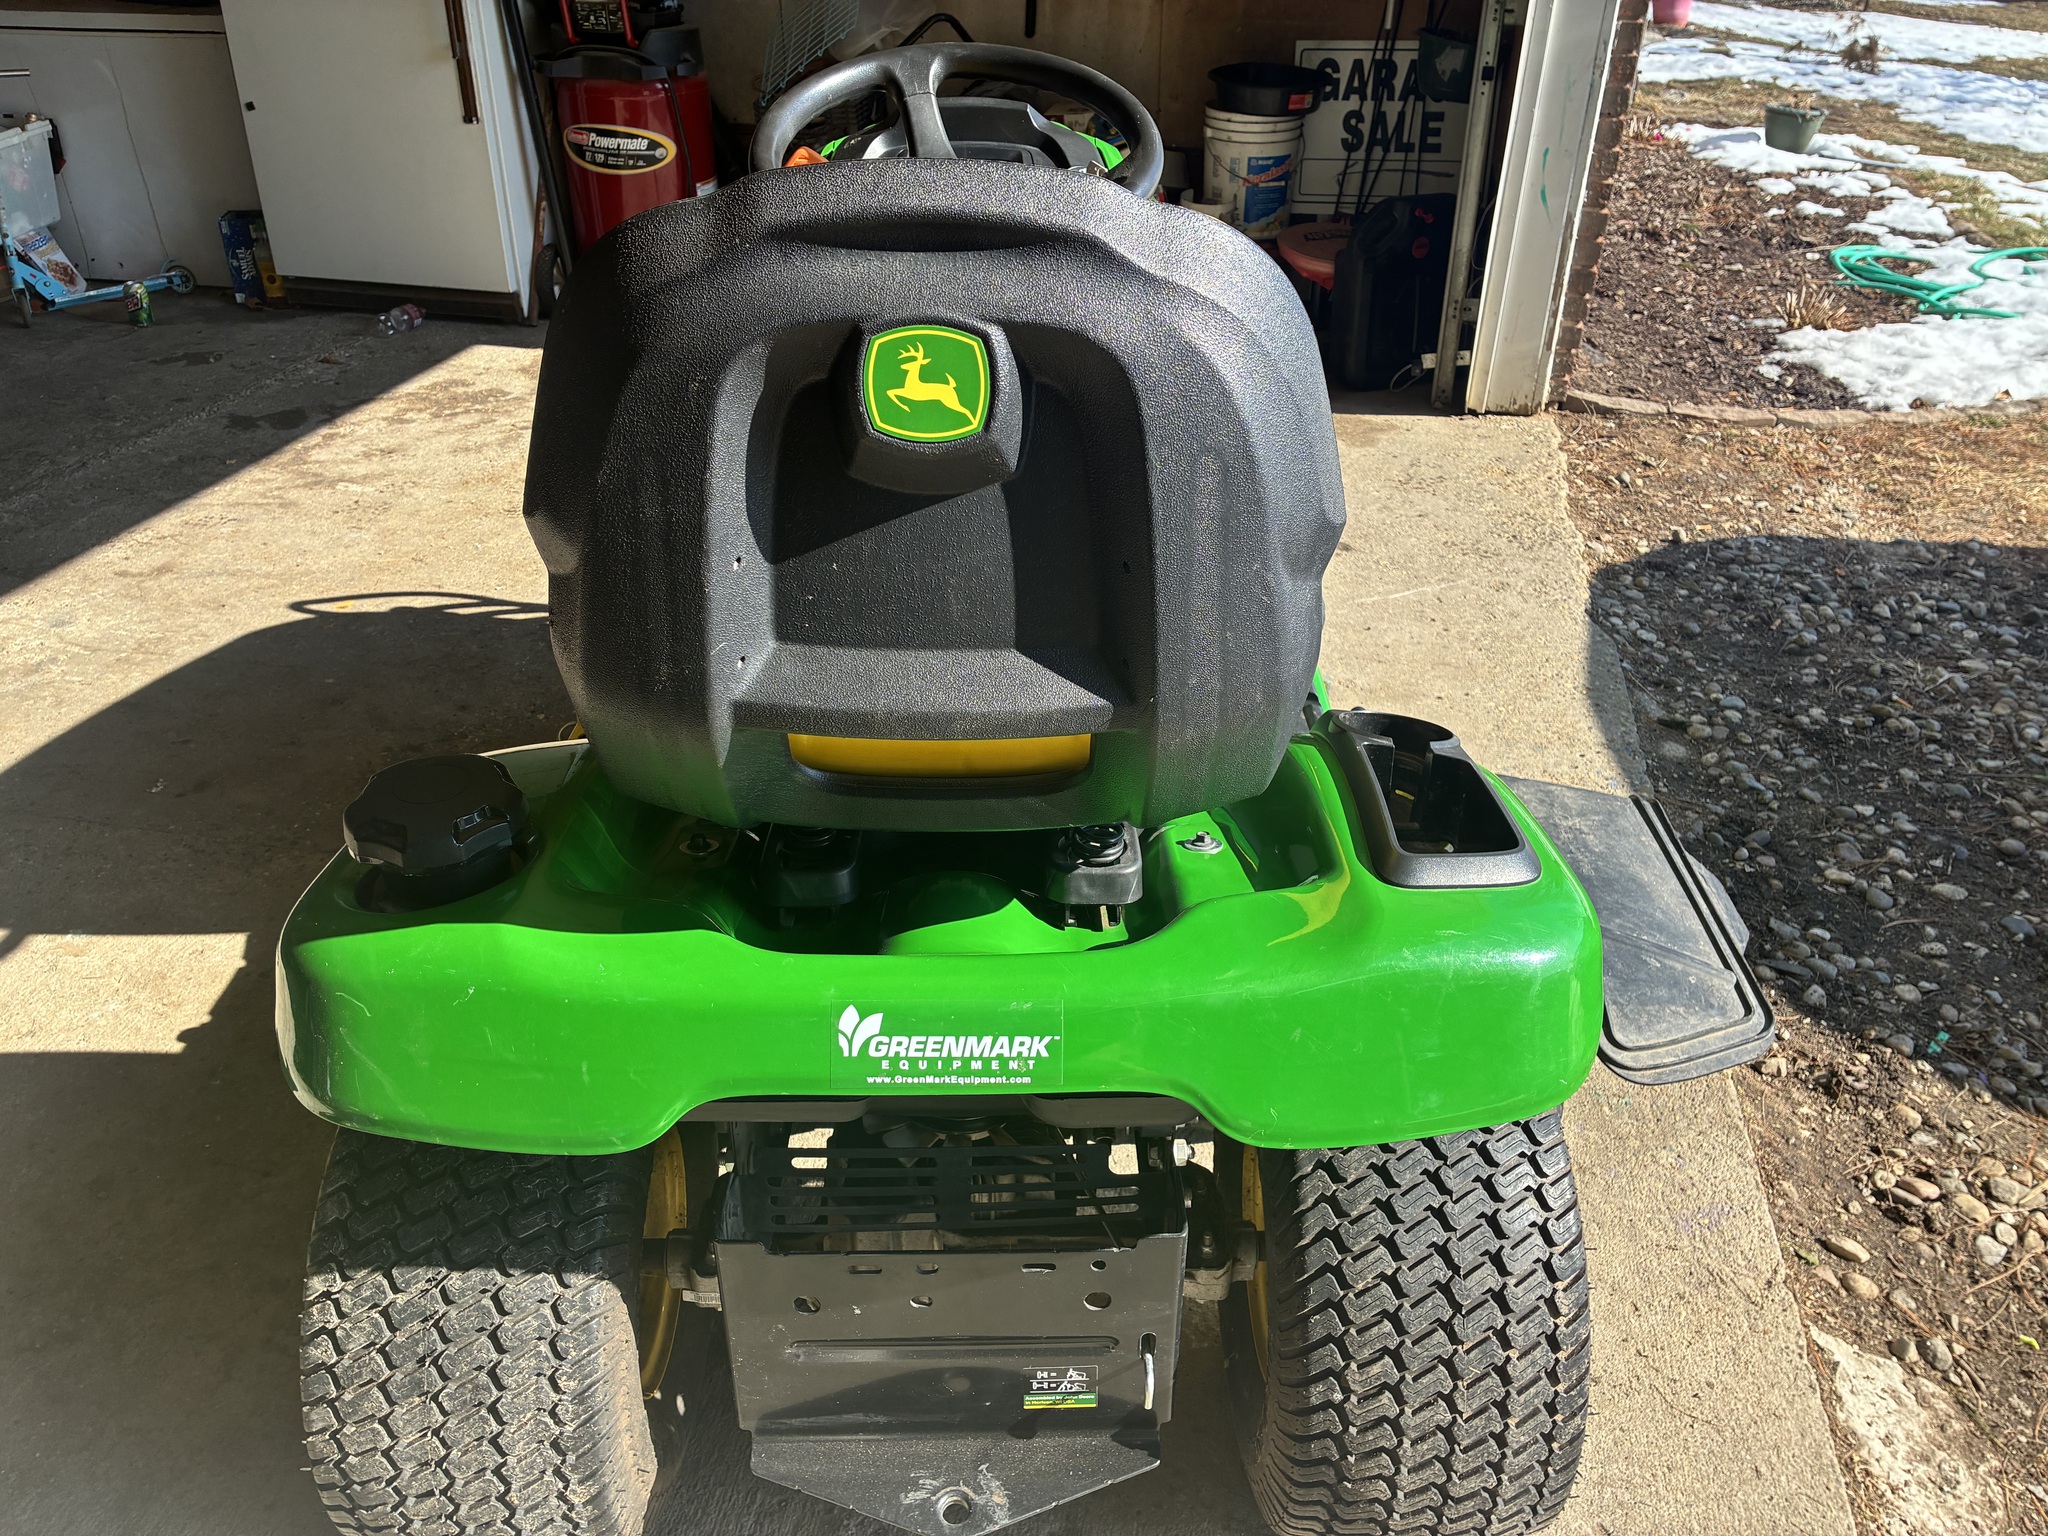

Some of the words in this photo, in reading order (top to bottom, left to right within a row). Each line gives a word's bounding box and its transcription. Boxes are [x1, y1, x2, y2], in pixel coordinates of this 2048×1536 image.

[1317, 58, 1442, 102] GARA
[588, 132, 648, 150] Powermate
[1341, 110, 1444, 153] SALE
[236, 246, 251, 280] SAMUEL
[868, 1035, 1052, 1058] GREENMARK
[881, 1060, 1035, 1071] EQUIPMENT
[866, 1074, 1032, 1086] www.GreenMarkEquipment.com
